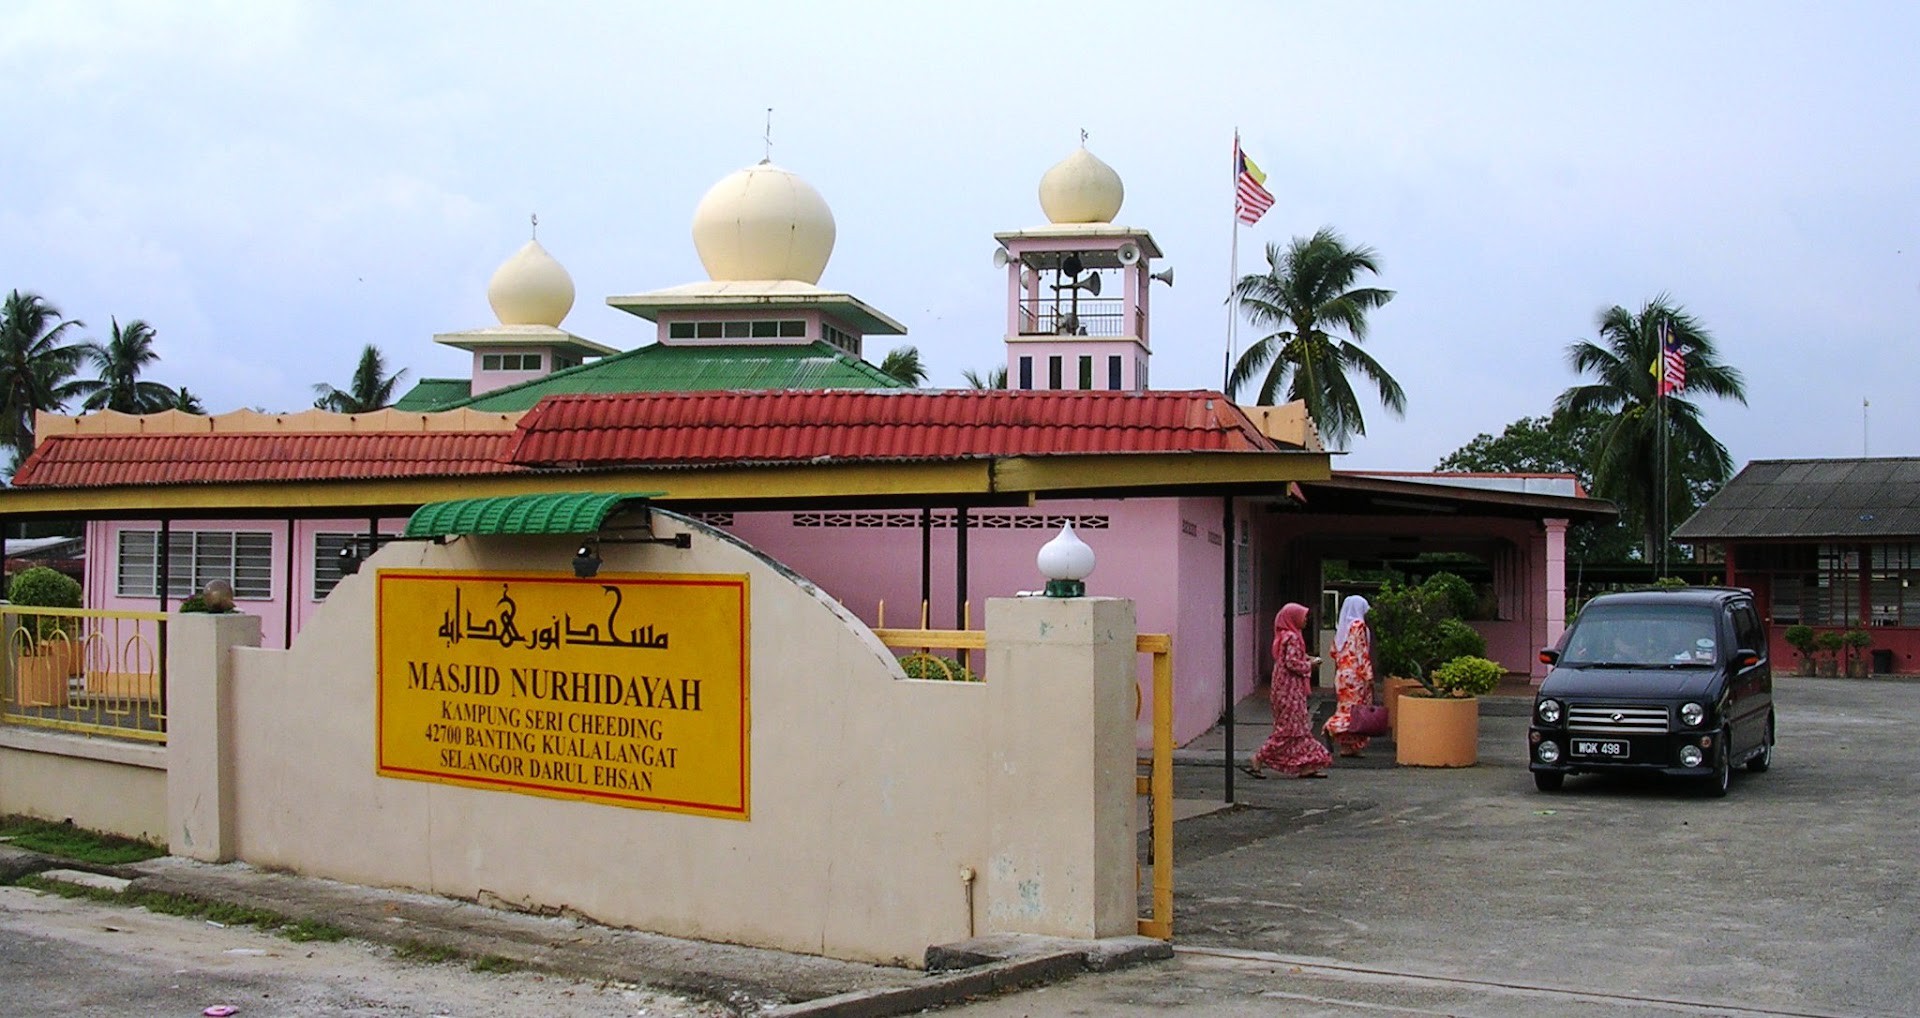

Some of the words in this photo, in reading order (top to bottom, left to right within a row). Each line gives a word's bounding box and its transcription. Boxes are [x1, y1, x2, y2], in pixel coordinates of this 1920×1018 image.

[407, 661, 500, 696] MASJID
[510, 668, 703, 711] NURHIDAYAH
[425, 723, 462, 745] 42700
[465, 726, 536, 754] BANTING
[441, 700, 521, 728] KAMPUNG
[525, 708, 563, 732] SERI
[568, 713, 663, 741] CHEEDING
[1579, 742, 1598, 754] WQK
[1601, 743, 1620, 755] 498
[440, 748, 524, 778] SELANGOR
[530, 758, 588, 785] DARUL
[593, 765, 653, 792] EHSAN
